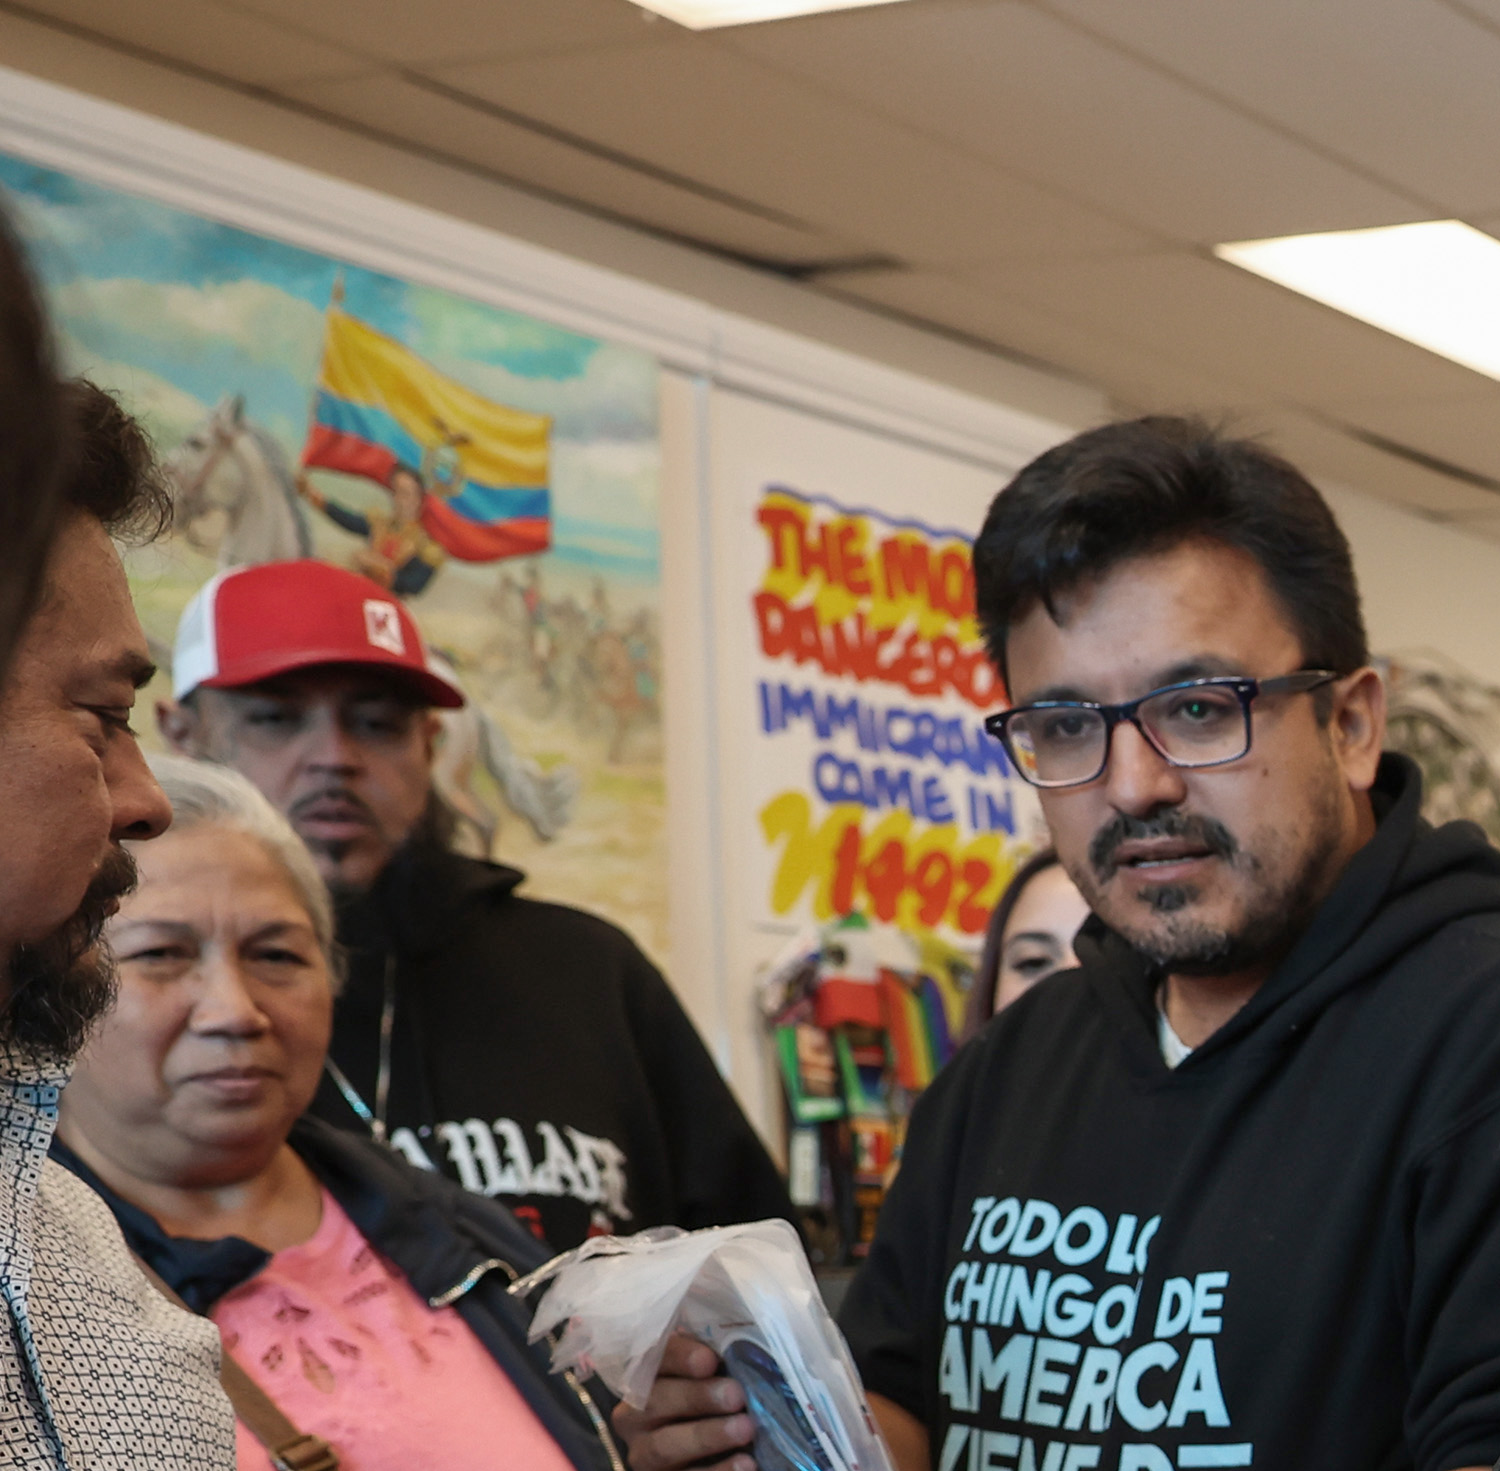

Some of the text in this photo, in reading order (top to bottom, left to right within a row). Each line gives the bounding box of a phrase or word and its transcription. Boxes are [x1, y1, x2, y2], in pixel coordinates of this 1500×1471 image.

[757, 507, 872, 596] THE
[815, 753, 1015, 836] COME IN
[829, 820, 994, 935] 1492
[962, 1196, 1109, 1267] TODO
[944, 1260, 1230, 1346] CHINGO DE
[939, 1324, 1231, 1432] AMERCA
